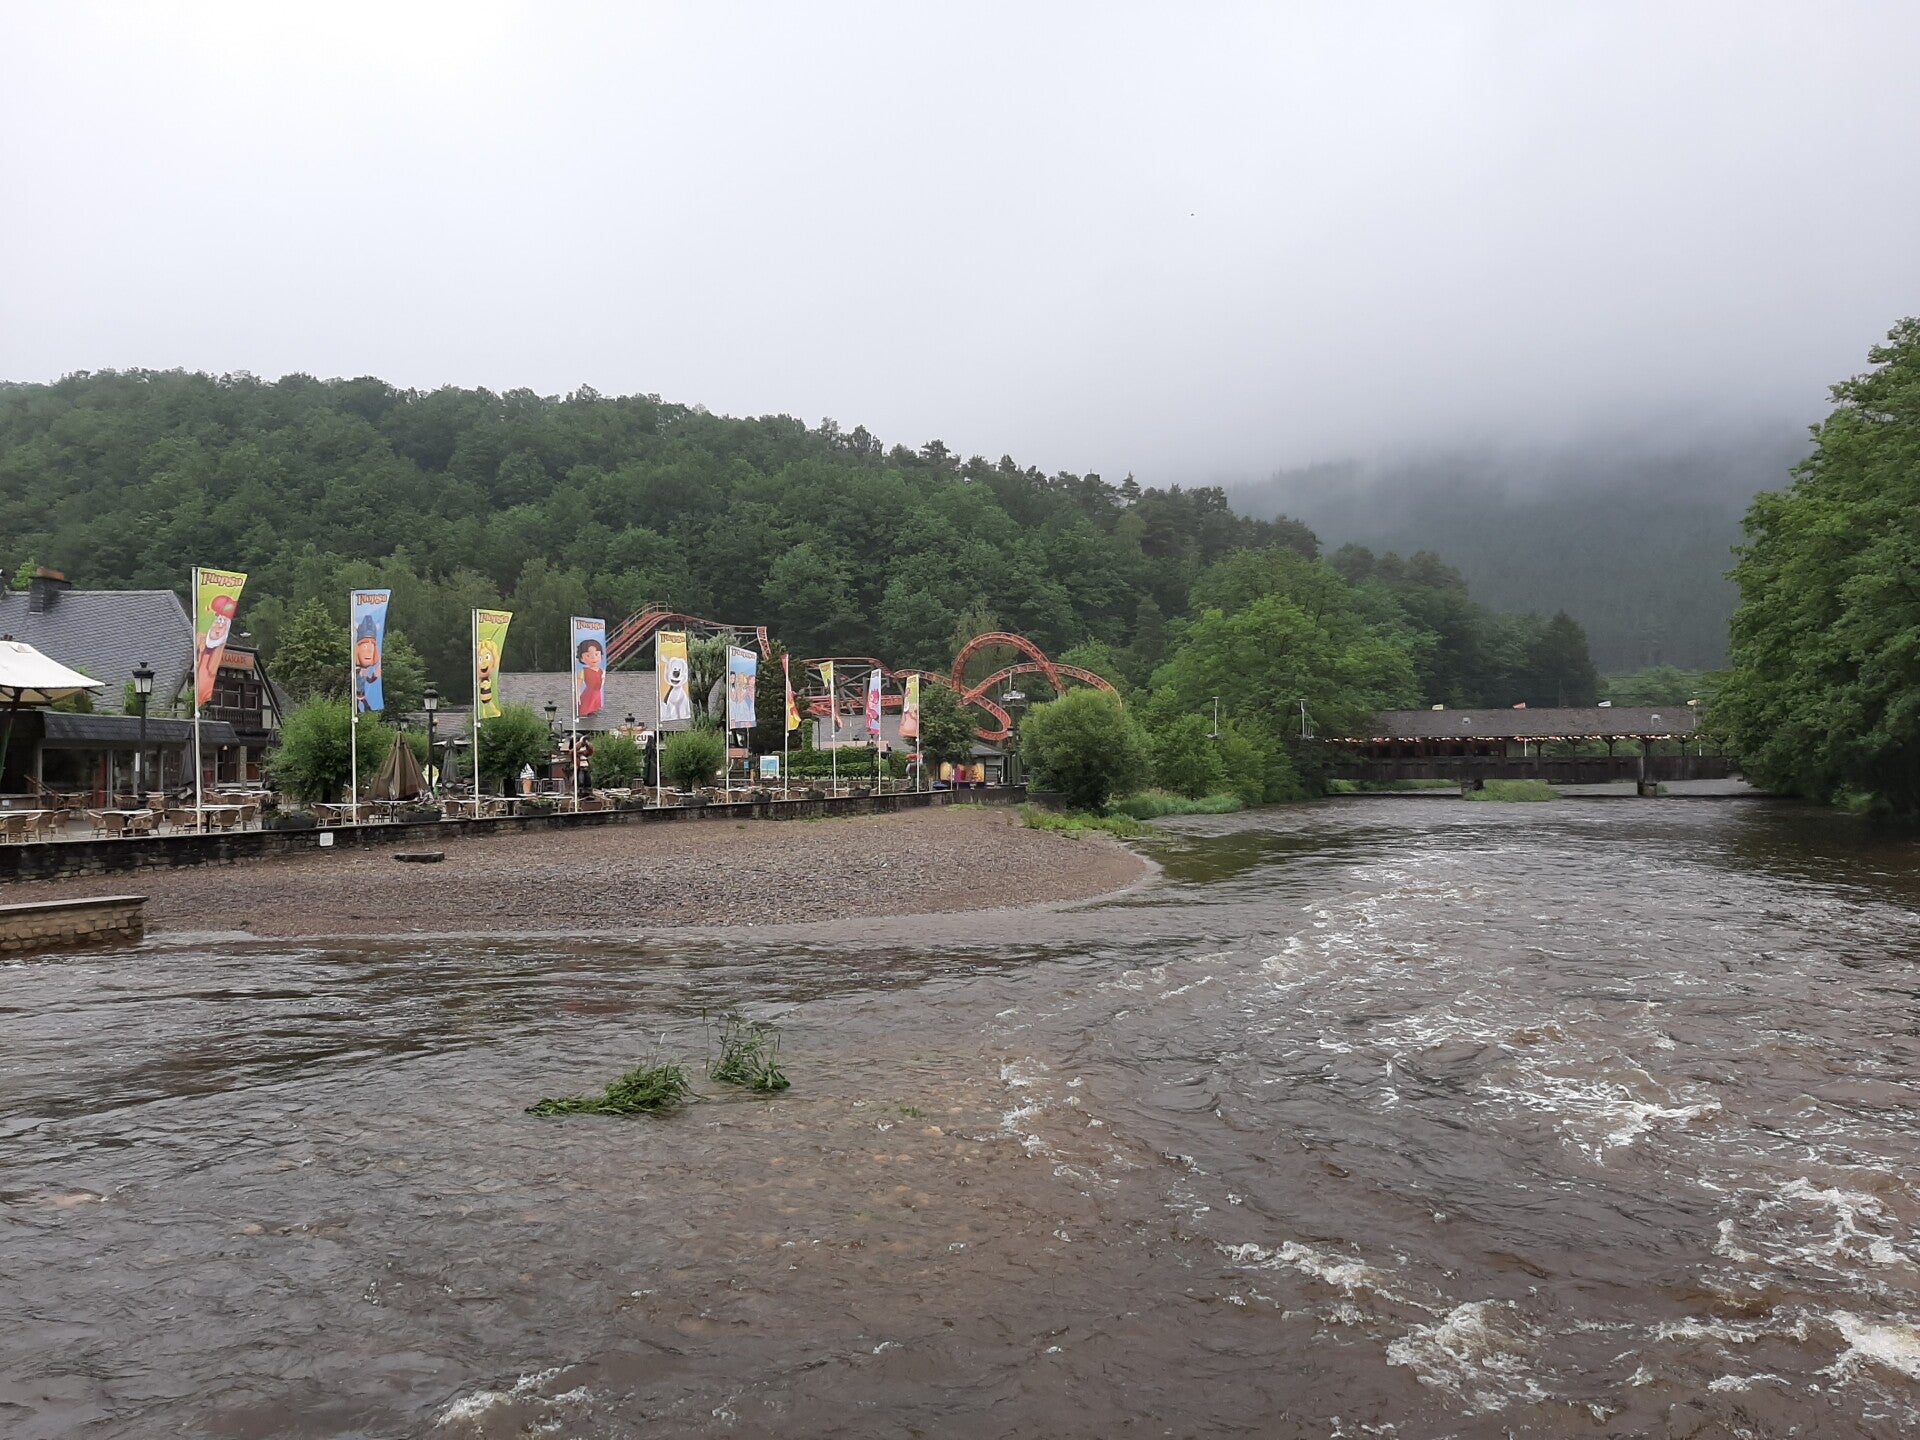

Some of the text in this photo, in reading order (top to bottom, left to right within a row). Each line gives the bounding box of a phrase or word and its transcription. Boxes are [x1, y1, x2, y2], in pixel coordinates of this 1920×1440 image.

[201, 572, 243, 587] Plopsa
[356, 593, 387, 605] Plopsa
[479, 612, 509, 624] Plopsa
[576, 619, 604, 630] Plopsa
